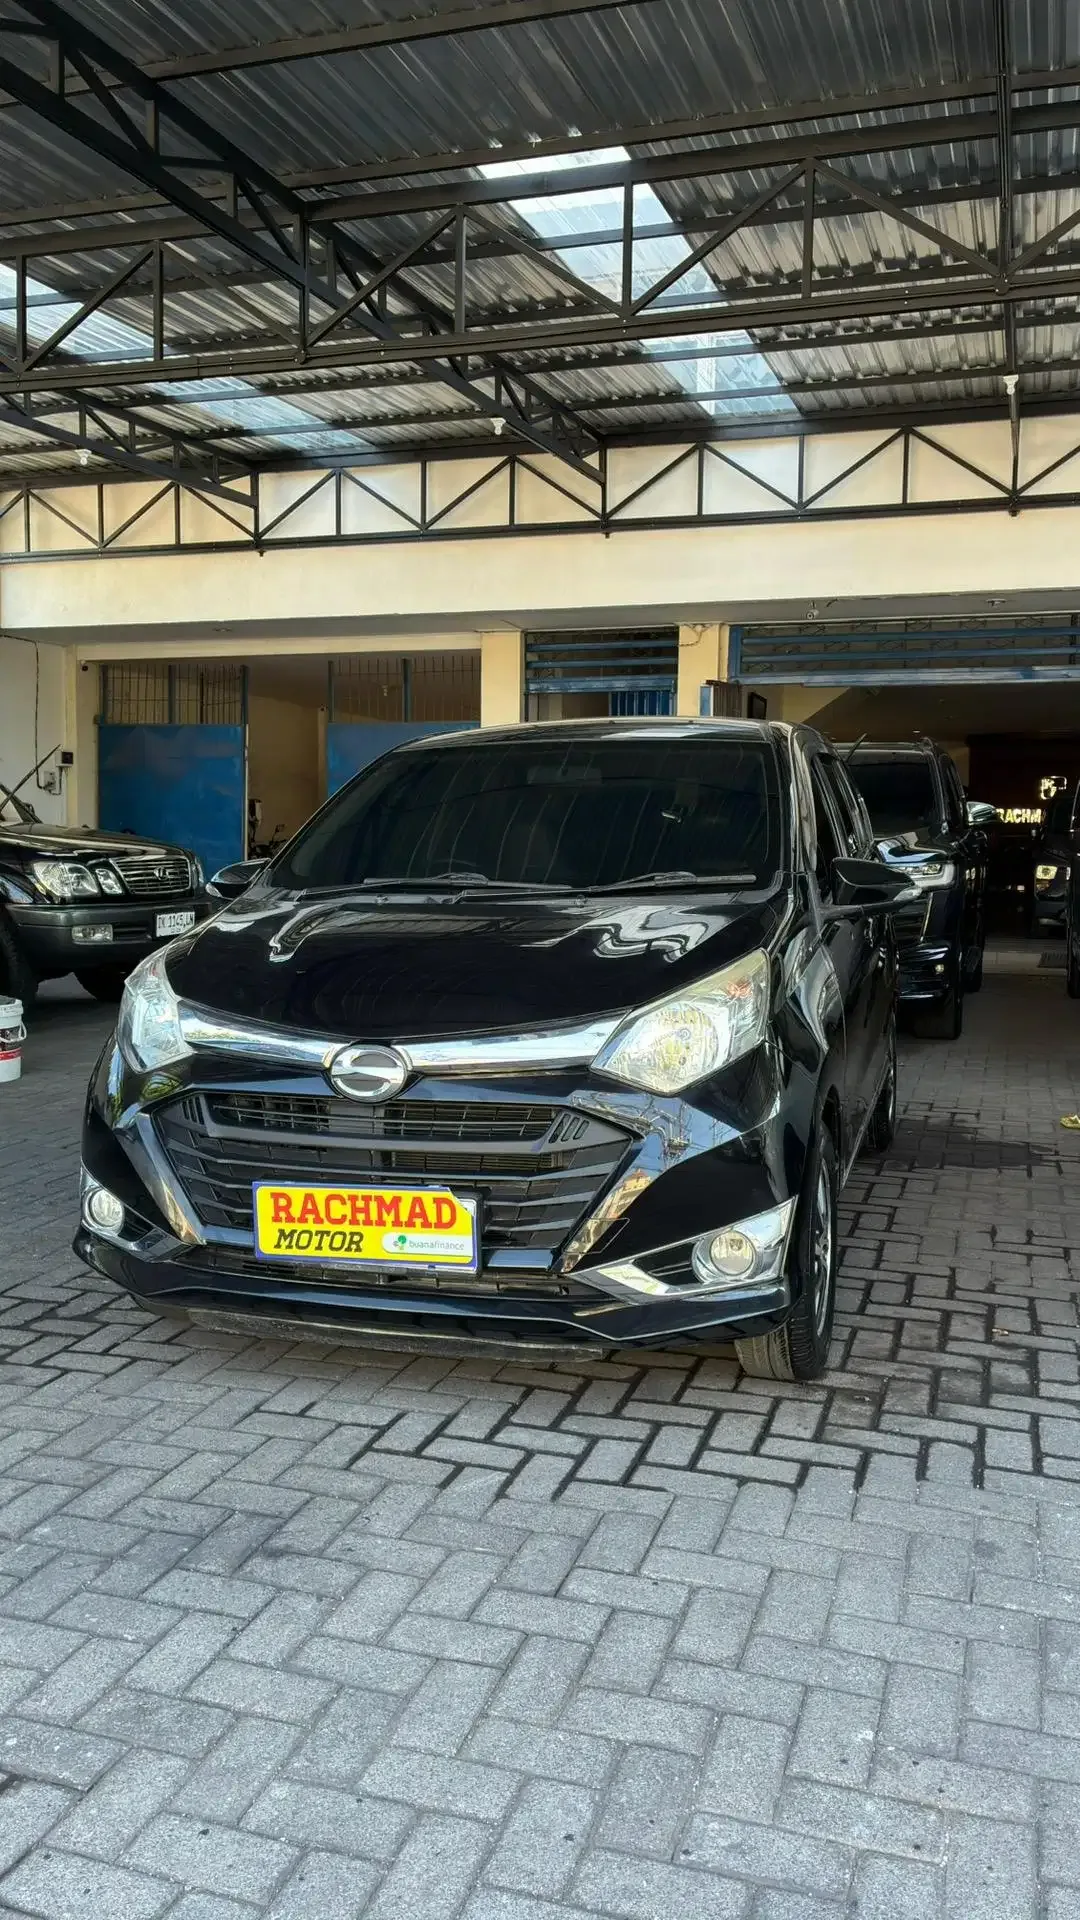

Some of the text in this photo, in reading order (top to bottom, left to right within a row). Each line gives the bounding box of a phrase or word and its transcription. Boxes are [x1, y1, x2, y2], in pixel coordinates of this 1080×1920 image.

[995, 808, 1046, 823] RACHM
[270, 1192, 457, 1229] RACHMAD
[274, 1229, 364, 1253] MOTOR
[408, 1240, 465, 1250] buanafinance
